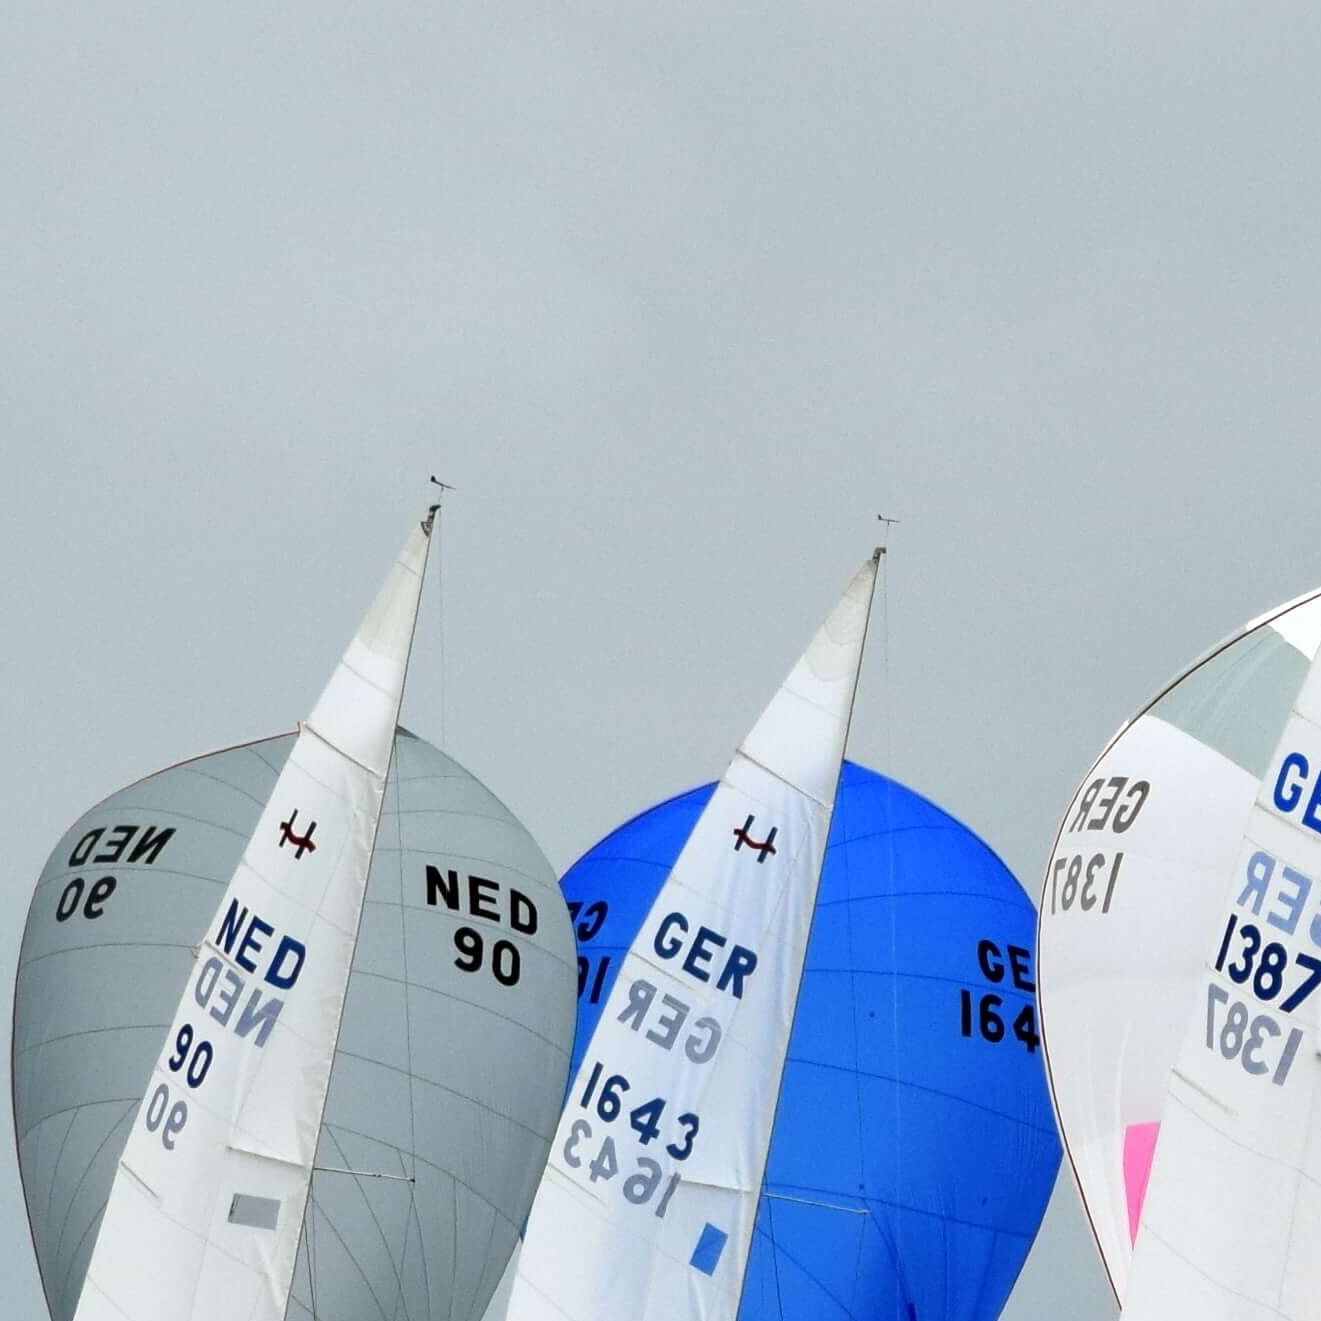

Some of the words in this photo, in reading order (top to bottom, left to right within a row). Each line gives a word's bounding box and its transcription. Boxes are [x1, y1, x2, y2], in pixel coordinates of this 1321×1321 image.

[425, 865, 538, 936] NED
[215, 898, 306, 990] NED
[453, 927, 521, 986] 90
[653, 911, 758, 999] GER
[169, 1024, 213, 1089] 90
[580, 1062, 701, 1161] 1643
